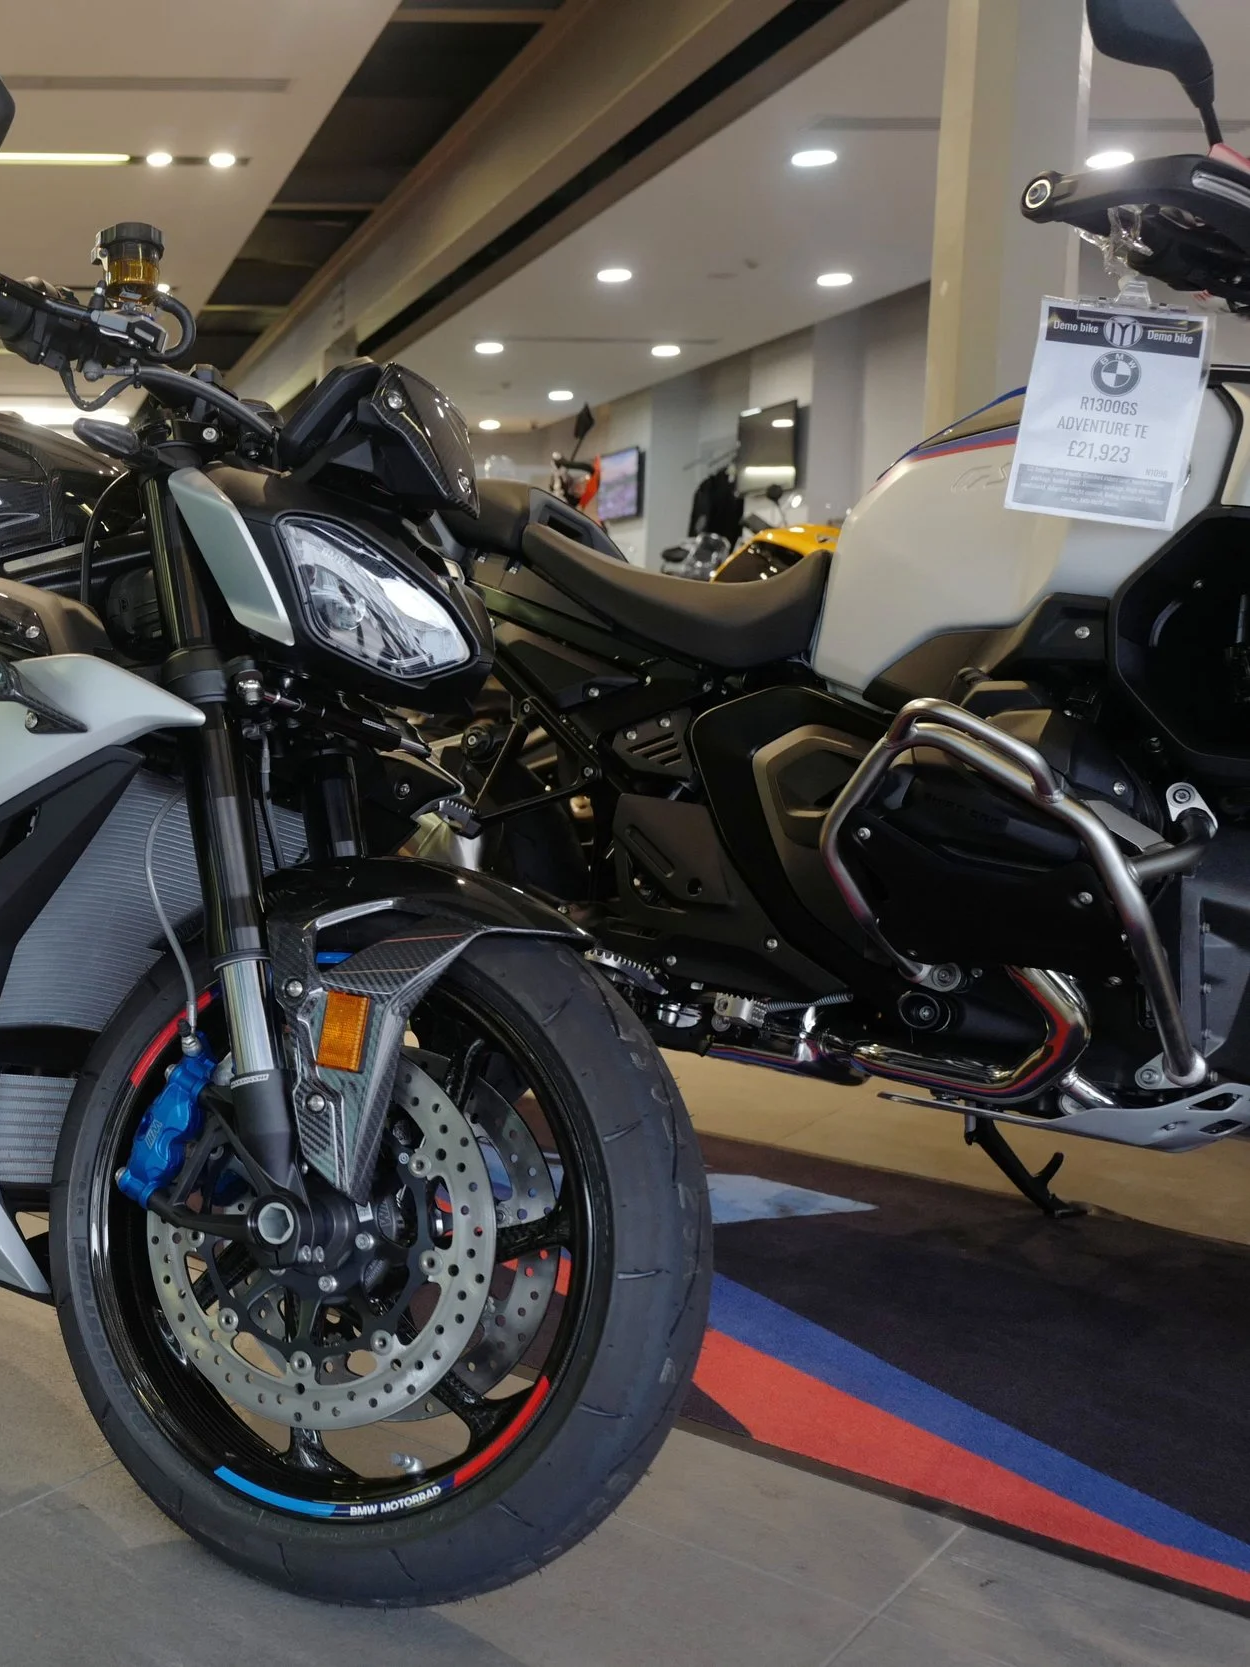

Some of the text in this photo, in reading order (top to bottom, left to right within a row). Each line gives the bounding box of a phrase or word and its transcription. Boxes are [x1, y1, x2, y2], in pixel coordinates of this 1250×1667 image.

[1053, 320, 1099, 334] Demo bike
[1147, 330, 1193, 344] Demo bike
[1100, 353, 1138, 369] BMW
[1079, 396, 1138, 416] R1300GS
[1056, 415, 1149, 439] ADVENTURE TE
[1066, 439, 1131, 464] £21,923
[349, 1485, 442, 1517] BMW MOTORRAD
